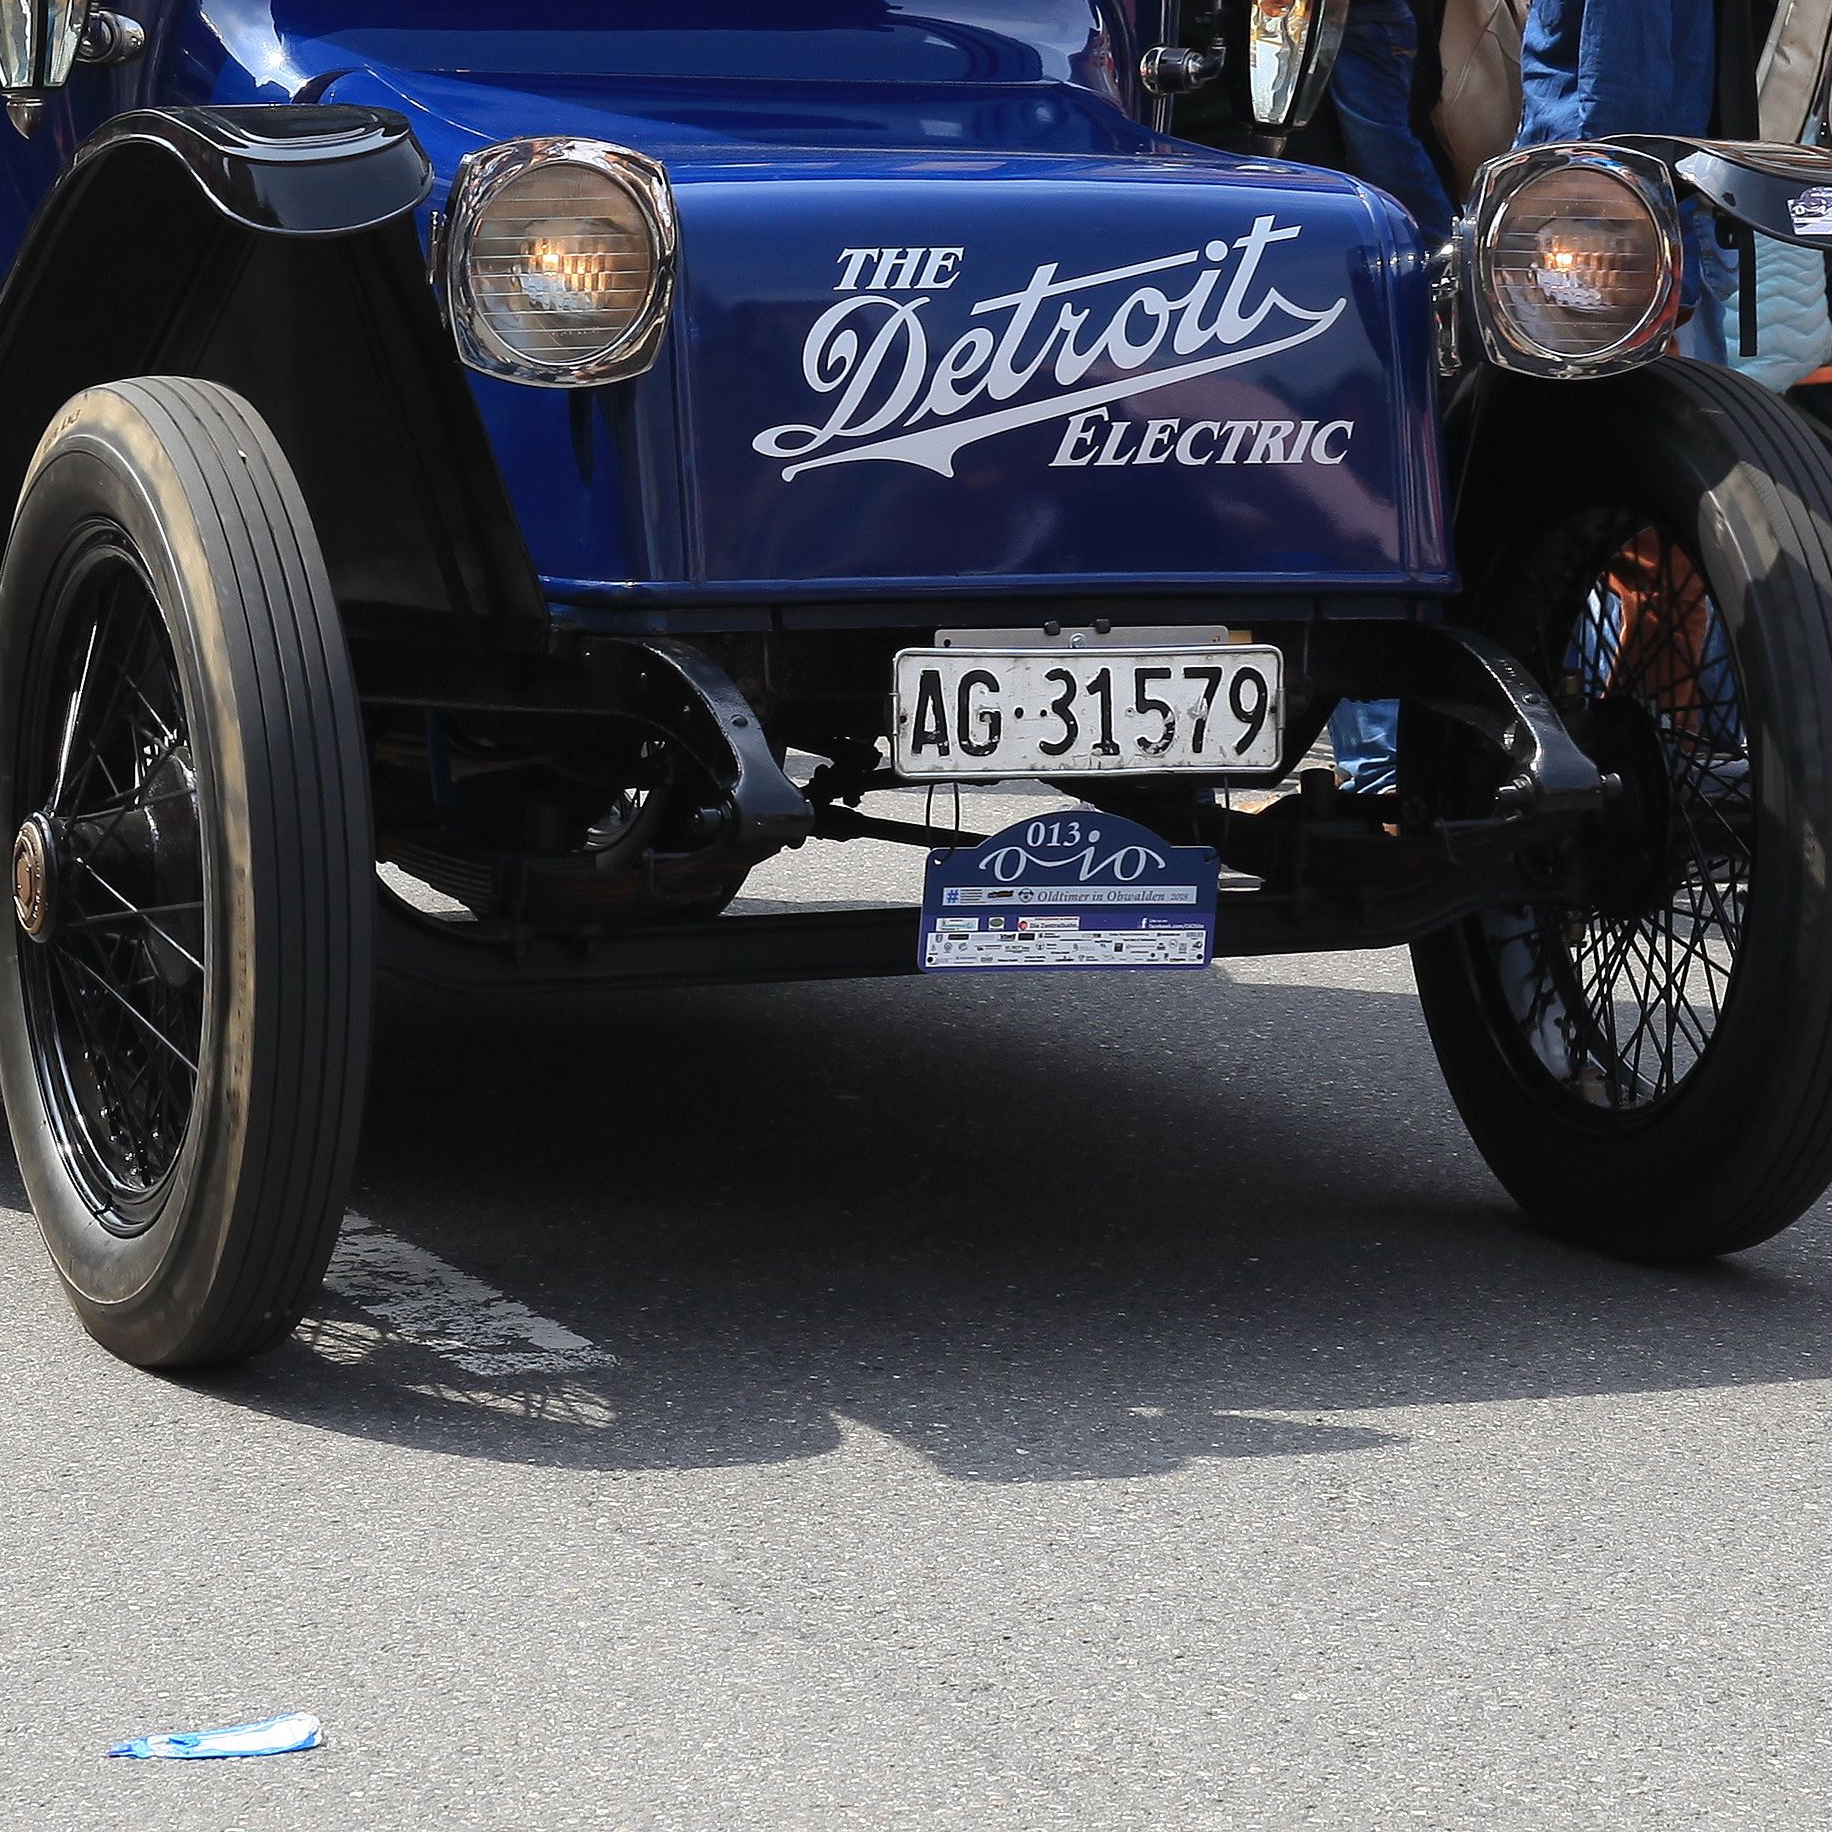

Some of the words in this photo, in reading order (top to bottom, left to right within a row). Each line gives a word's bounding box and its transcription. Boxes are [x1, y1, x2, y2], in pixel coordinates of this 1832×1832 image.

[832, 246, 964, 290] THE
[751, 214, 1347, 481] Detroit
[1048, 406, 1356, 468] ELECTRIC
[911, 668, 1002, 757] AG
[1038, 666, 1269, 757] 31579
[1026, 820, 1081, 848] 013
[1036, 889, 1089, 903] Oldtimer
[1091, 889, 1103, 902] in
[1106, 889, 1166, 902] Obwalden
